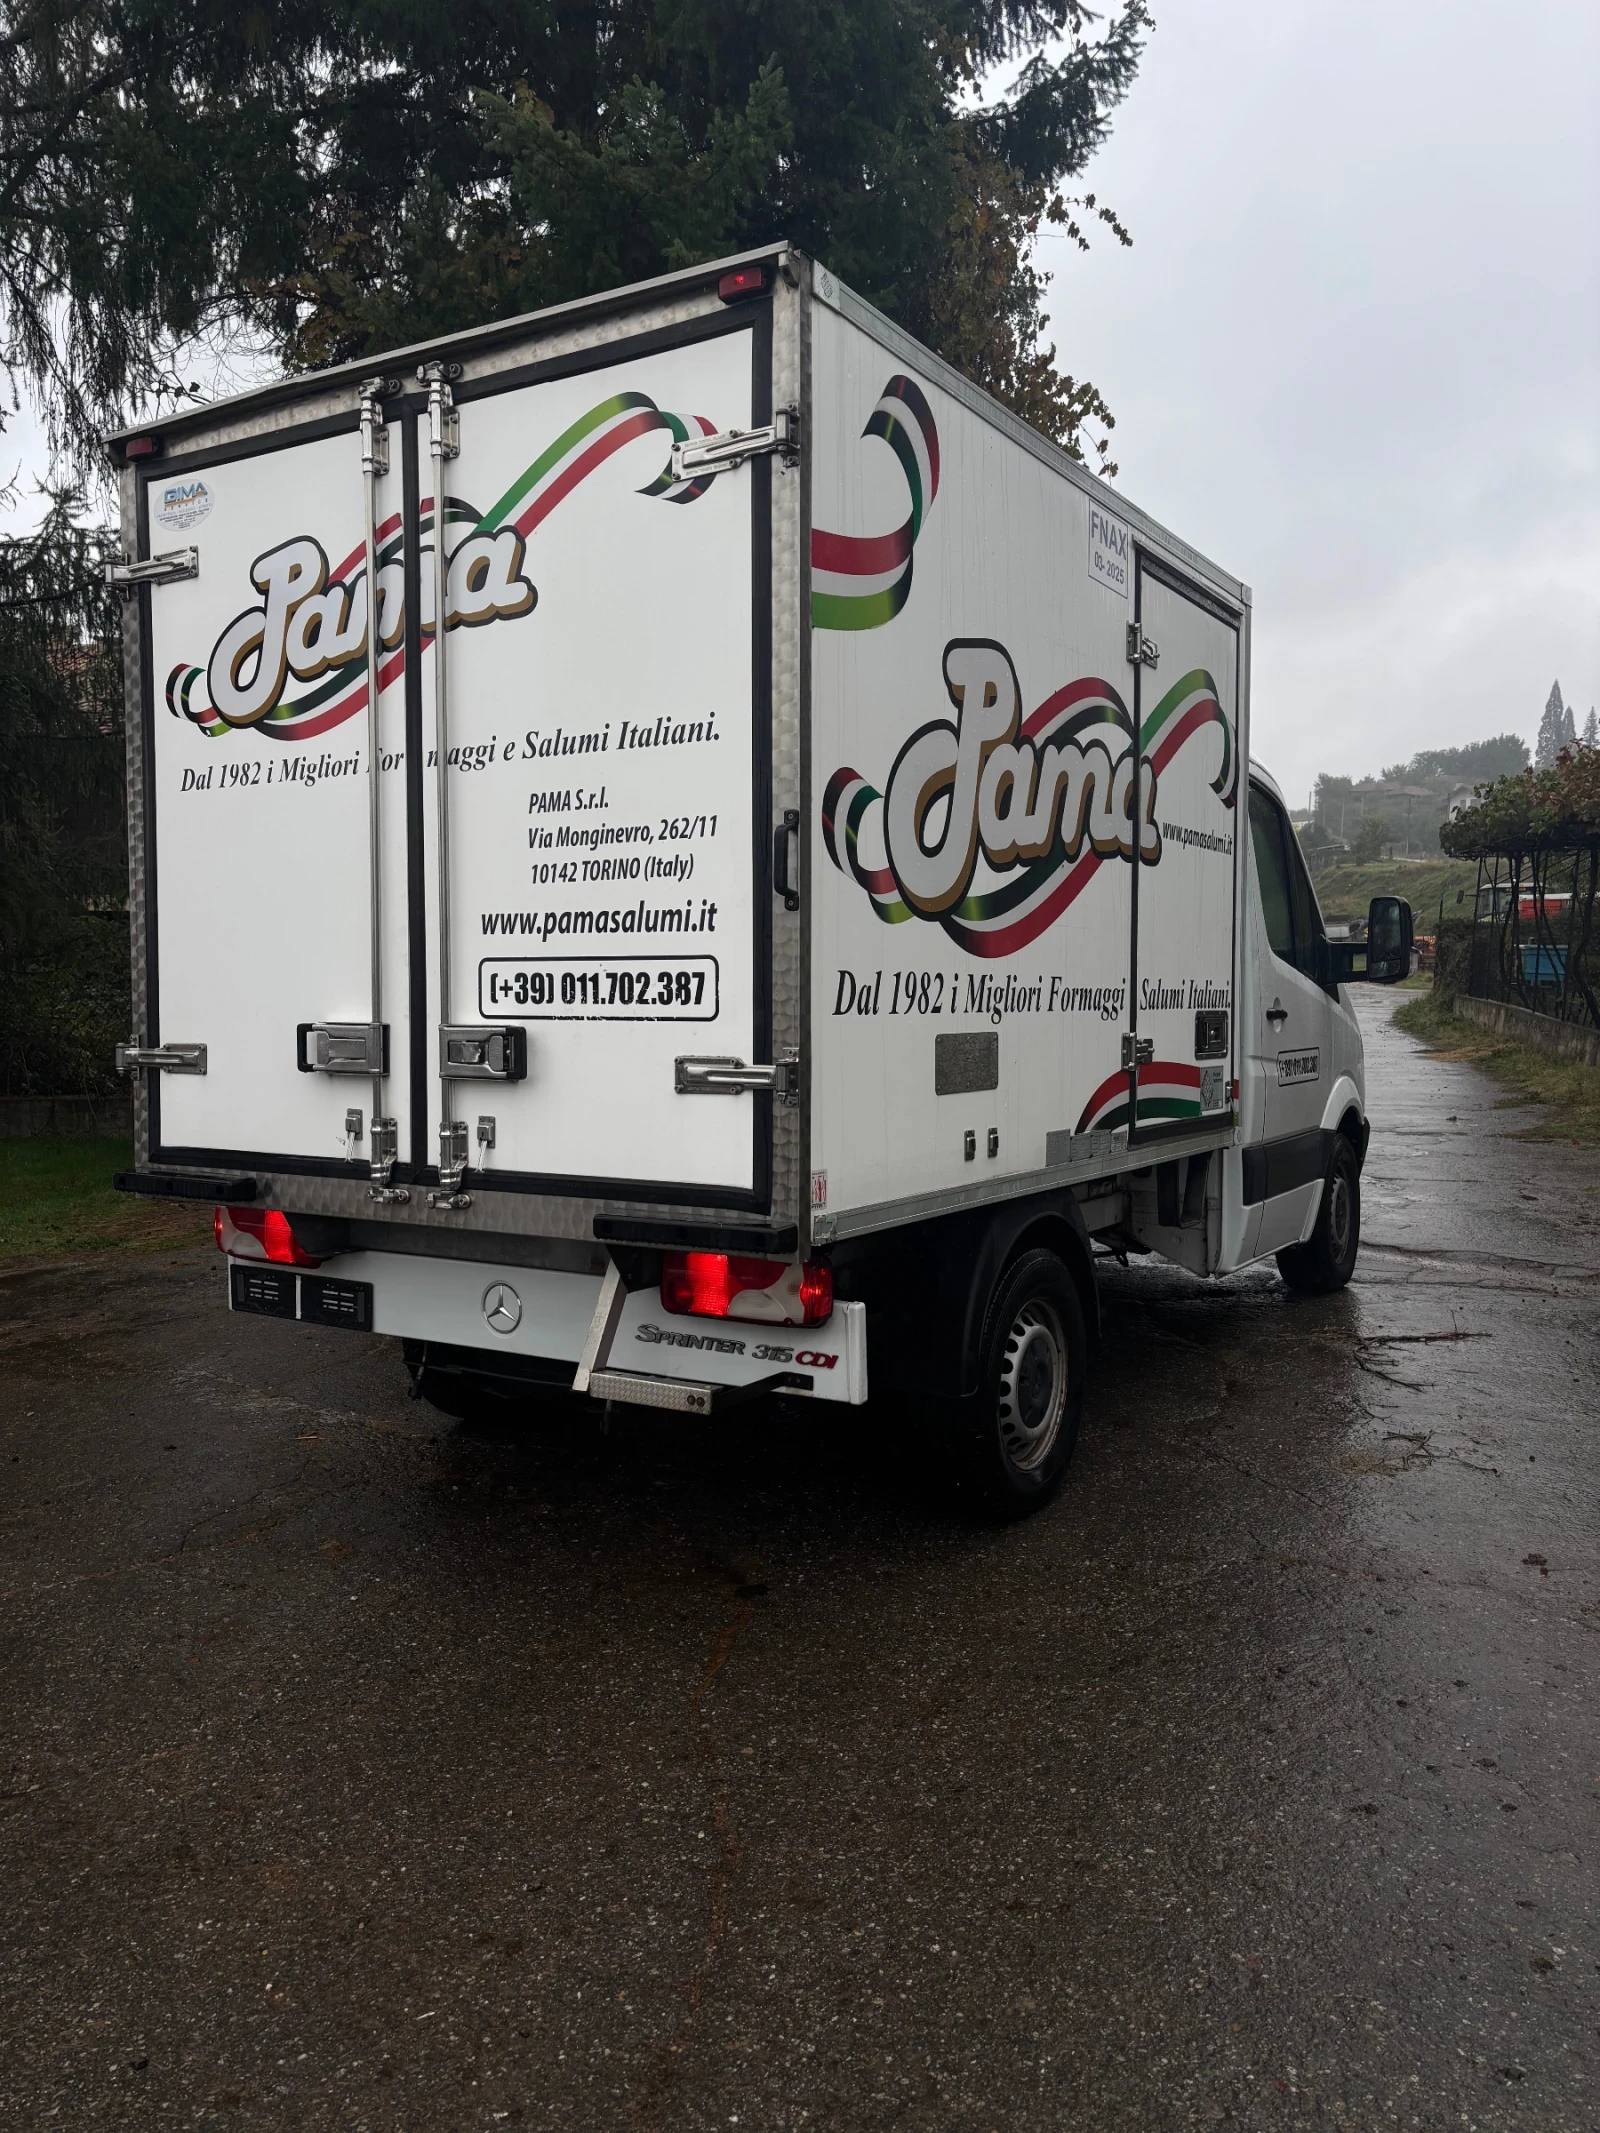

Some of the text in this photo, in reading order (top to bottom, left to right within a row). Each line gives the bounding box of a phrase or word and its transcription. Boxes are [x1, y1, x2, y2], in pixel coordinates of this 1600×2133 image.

[164, 482, 208, 504] GIMA
[1091, 510, 1127, 560] FNAX
[207, 525, 538, 729] Pama
[180, 711, 720, 792] Dal 1982 i Migliori ormaggi e Salumi Italiani.
[528, 786, 609, 814] PAMA S.r.l.
[884, 638, 1162, 922] Pama
[528, 815, 718, 851] Via Monginevro, 262/11
[1162, 822, 1233, 856] www.pamasalumi.it
[531, 853, 694, 884] 10142 TORINO (Italy)
[481, 899, 718, 942] www.pamasalumi.it
[490, 971, 706, 1006] (+39) 011.702.387
[832, 969, 1231, 1024] Dal 1982 i Migliori Formaggi Salumi Italiani.
[635, 1324, 839, 1369] SPRINTER 315 CDI
